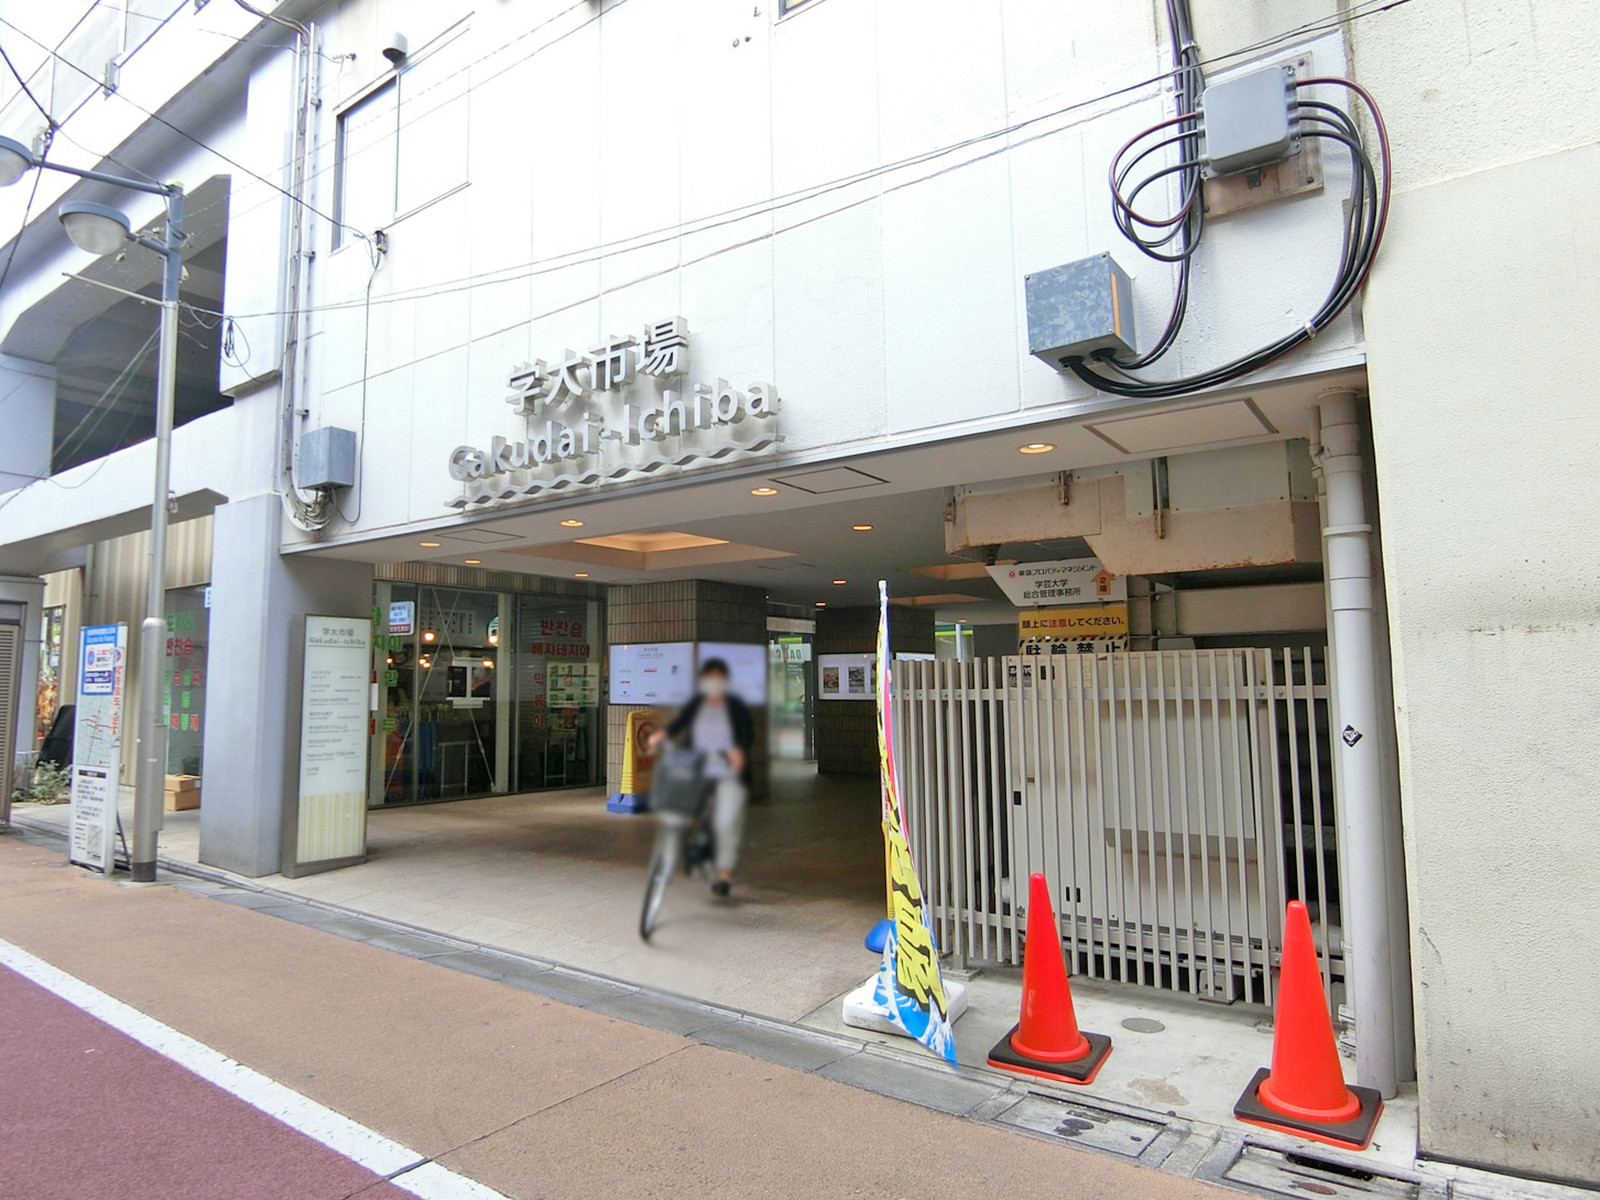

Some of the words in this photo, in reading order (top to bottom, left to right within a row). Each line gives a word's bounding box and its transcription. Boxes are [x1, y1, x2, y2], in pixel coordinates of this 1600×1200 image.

[506, 316, 690, 415] 学大市場
[448, 378, 781, 482] Gakudai-Ichiba
[1018, 565, 1097, 577] 東急プロパティマネジメント
[1035, 578, 1068, 589] 学芸大学
[1023, 587, 1081, 599] 総合管理事務所
[1022, 616, 1125, 629] 頭上に注意してください。
